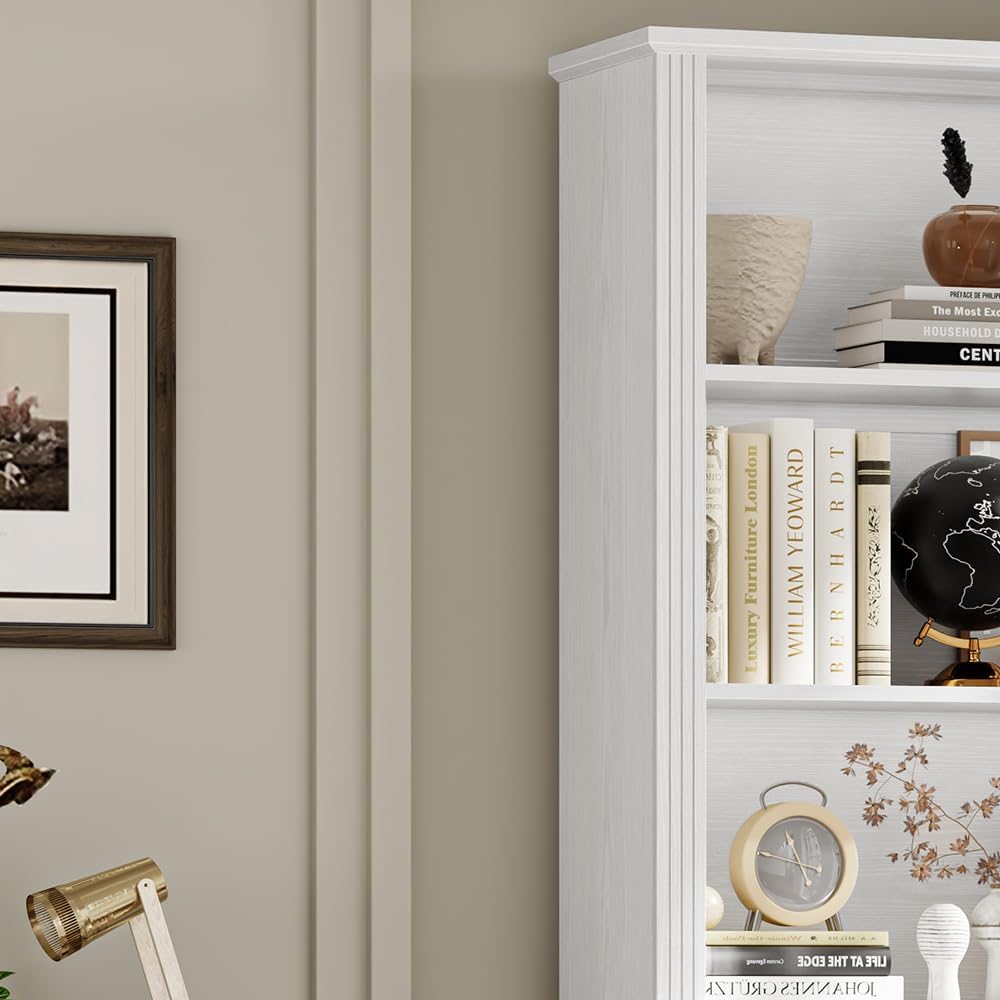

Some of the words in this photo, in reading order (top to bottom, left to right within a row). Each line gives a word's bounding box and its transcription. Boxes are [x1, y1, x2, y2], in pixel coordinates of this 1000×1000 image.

[932, 305, 951, 316] The
[954, 306, 982, 317] Most
[974, 291, 981, 299] DE
[923, 325, 992, 338] HOUSEHOLD
[745, 445, 758, 513] London
[786, 448, 804, 556] YEOWARD
[744, 519, 758, 604] Furniture
[829, 446, 845, 673] BERNHARDT
[745, 611, 760, 673] Luxury
[787, 565, 804, 658] WILLIAM
